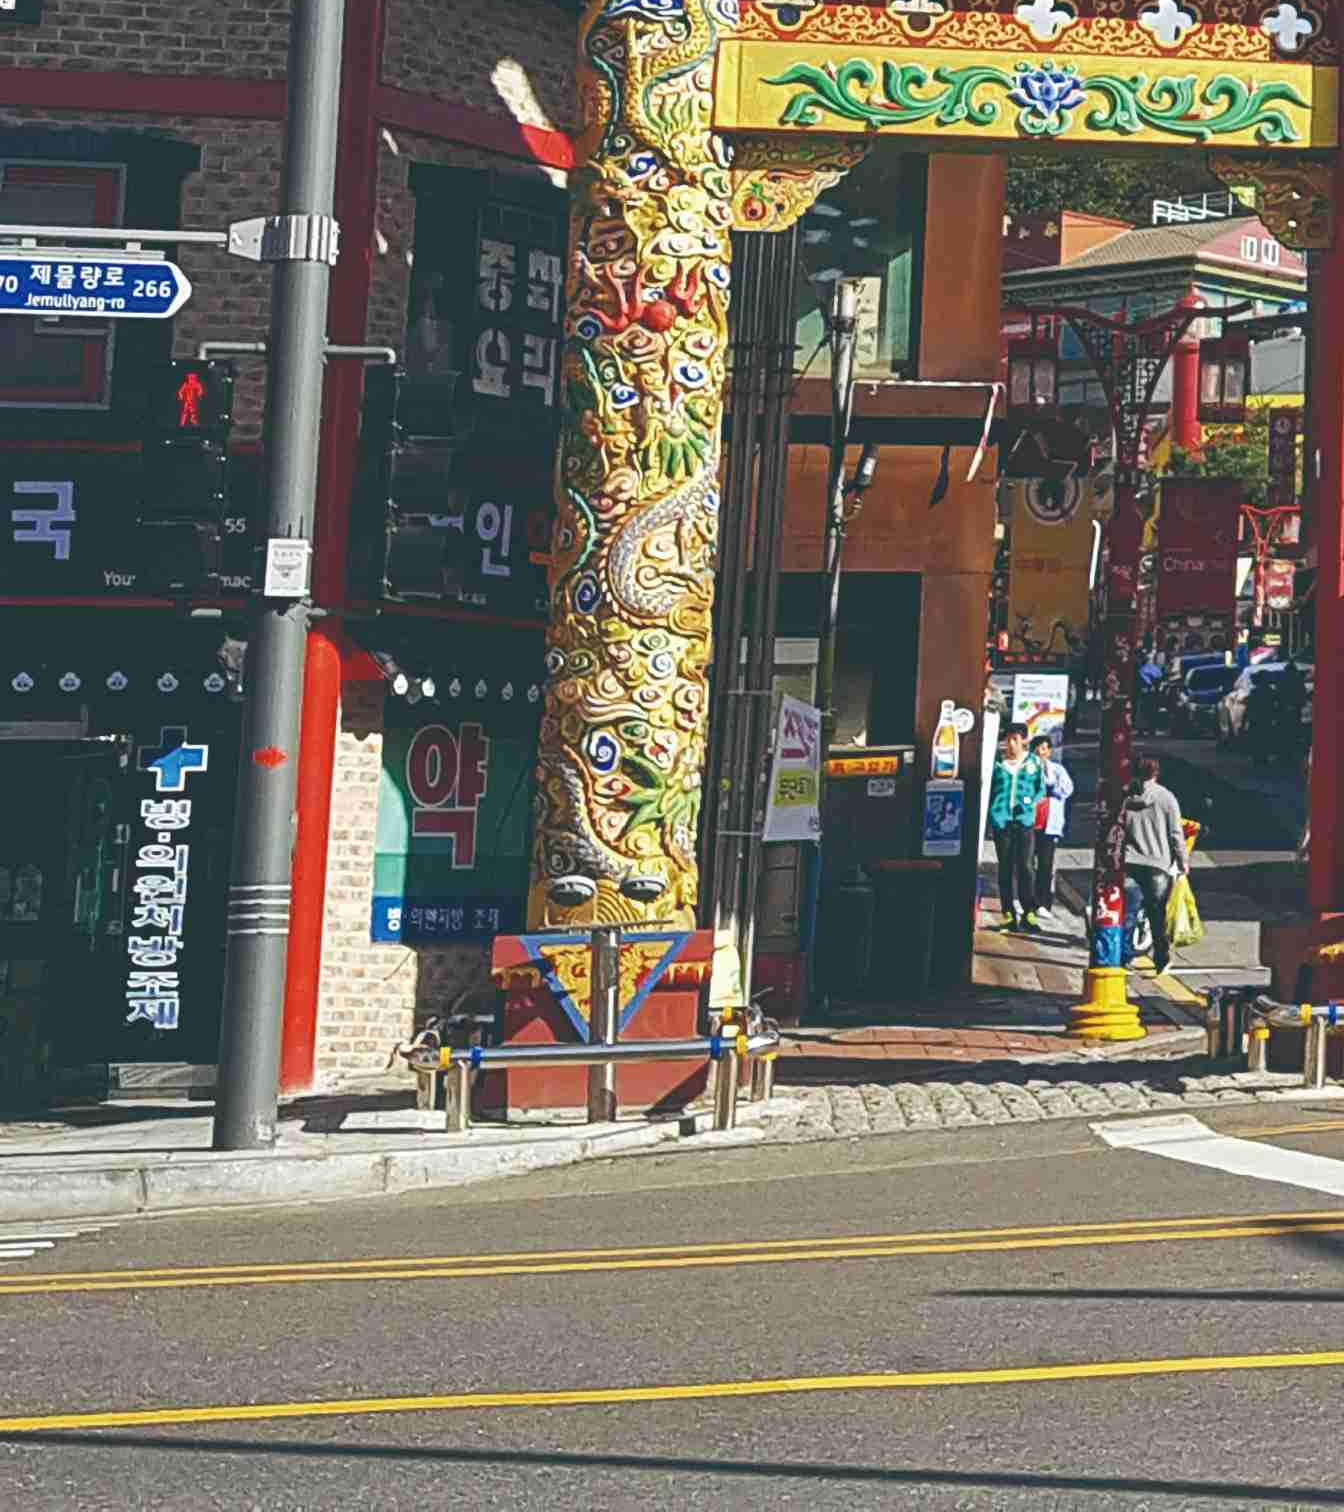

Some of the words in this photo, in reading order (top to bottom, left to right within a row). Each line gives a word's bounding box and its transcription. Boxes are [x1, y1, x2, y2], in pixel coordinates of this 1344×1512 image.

[24, 292, 126, 312] Jemullyang-ro
[29, 264, 126, 290] 제물량로
[131, 279, 172, 298] 266
[11, 480, 76, 560] 국
[406, 723, 490, 870] 약
